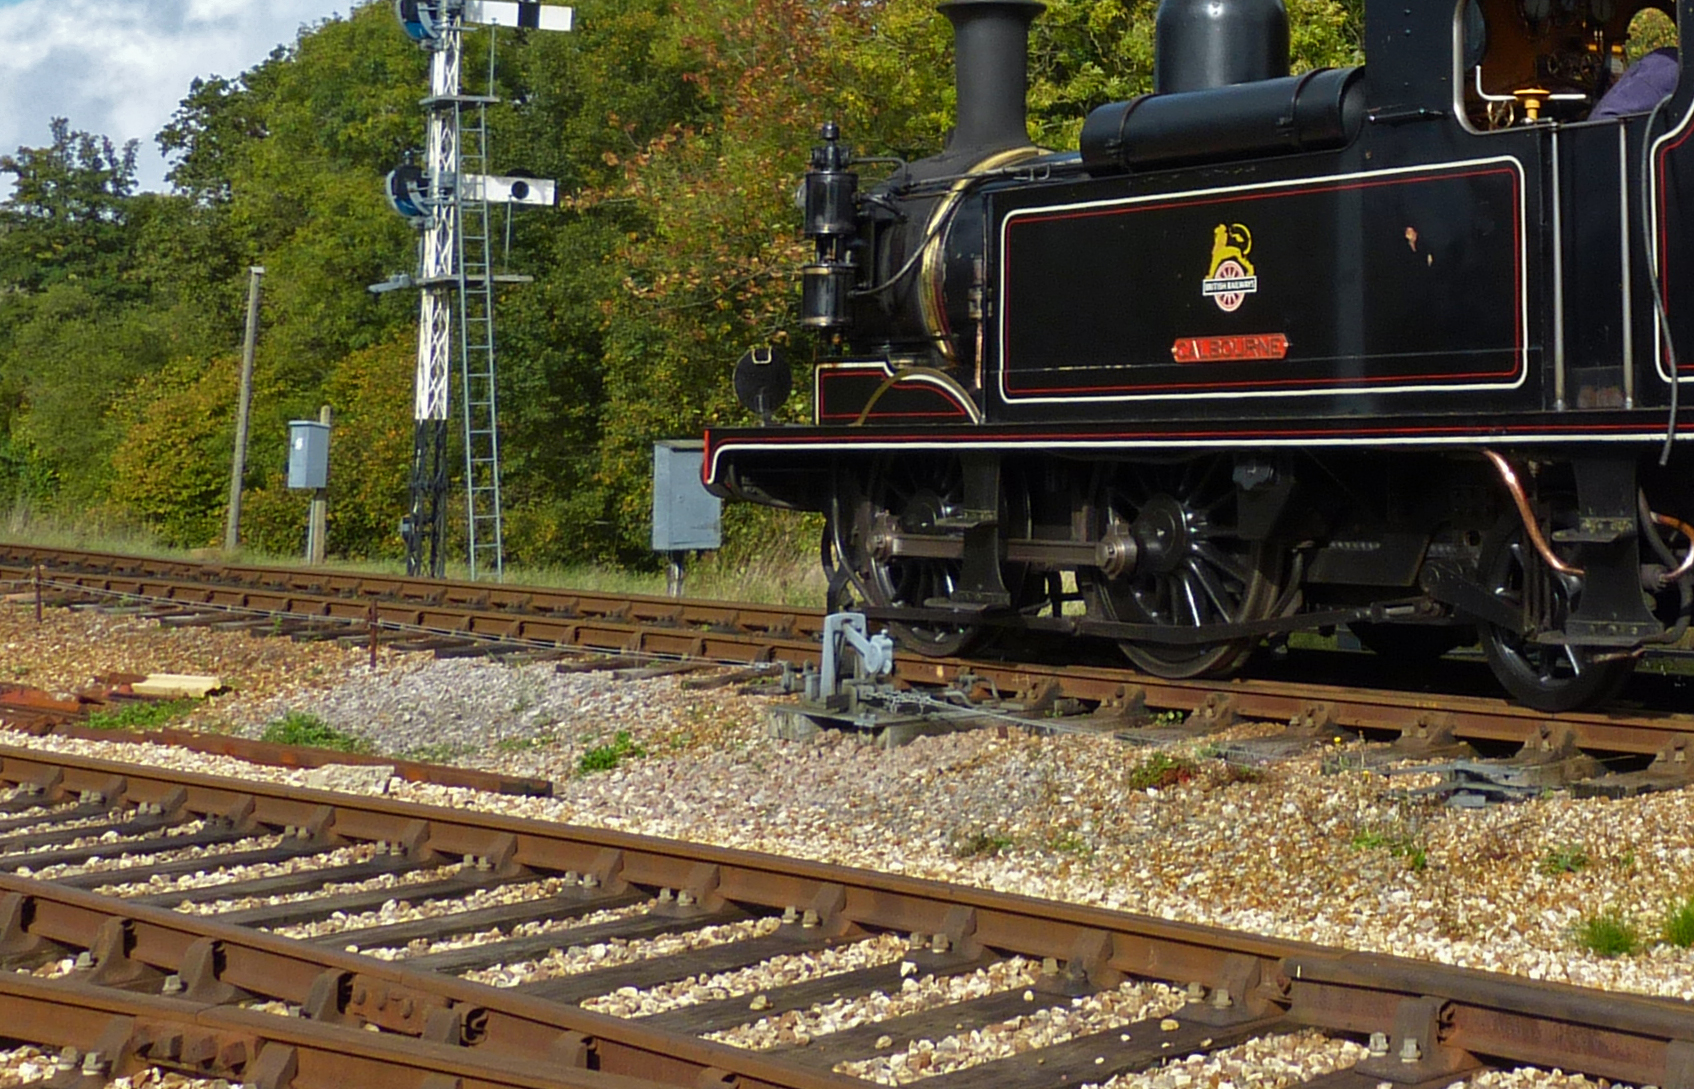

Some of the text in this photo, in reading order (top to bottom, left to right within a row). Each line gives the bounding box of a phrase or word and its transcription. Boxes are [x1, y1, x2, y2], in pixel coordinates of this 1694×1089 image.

[1205, 279, 1255, 292] BRITISH RAILWAYS
[1177, 335, 1283, 359] CALBOURNE
